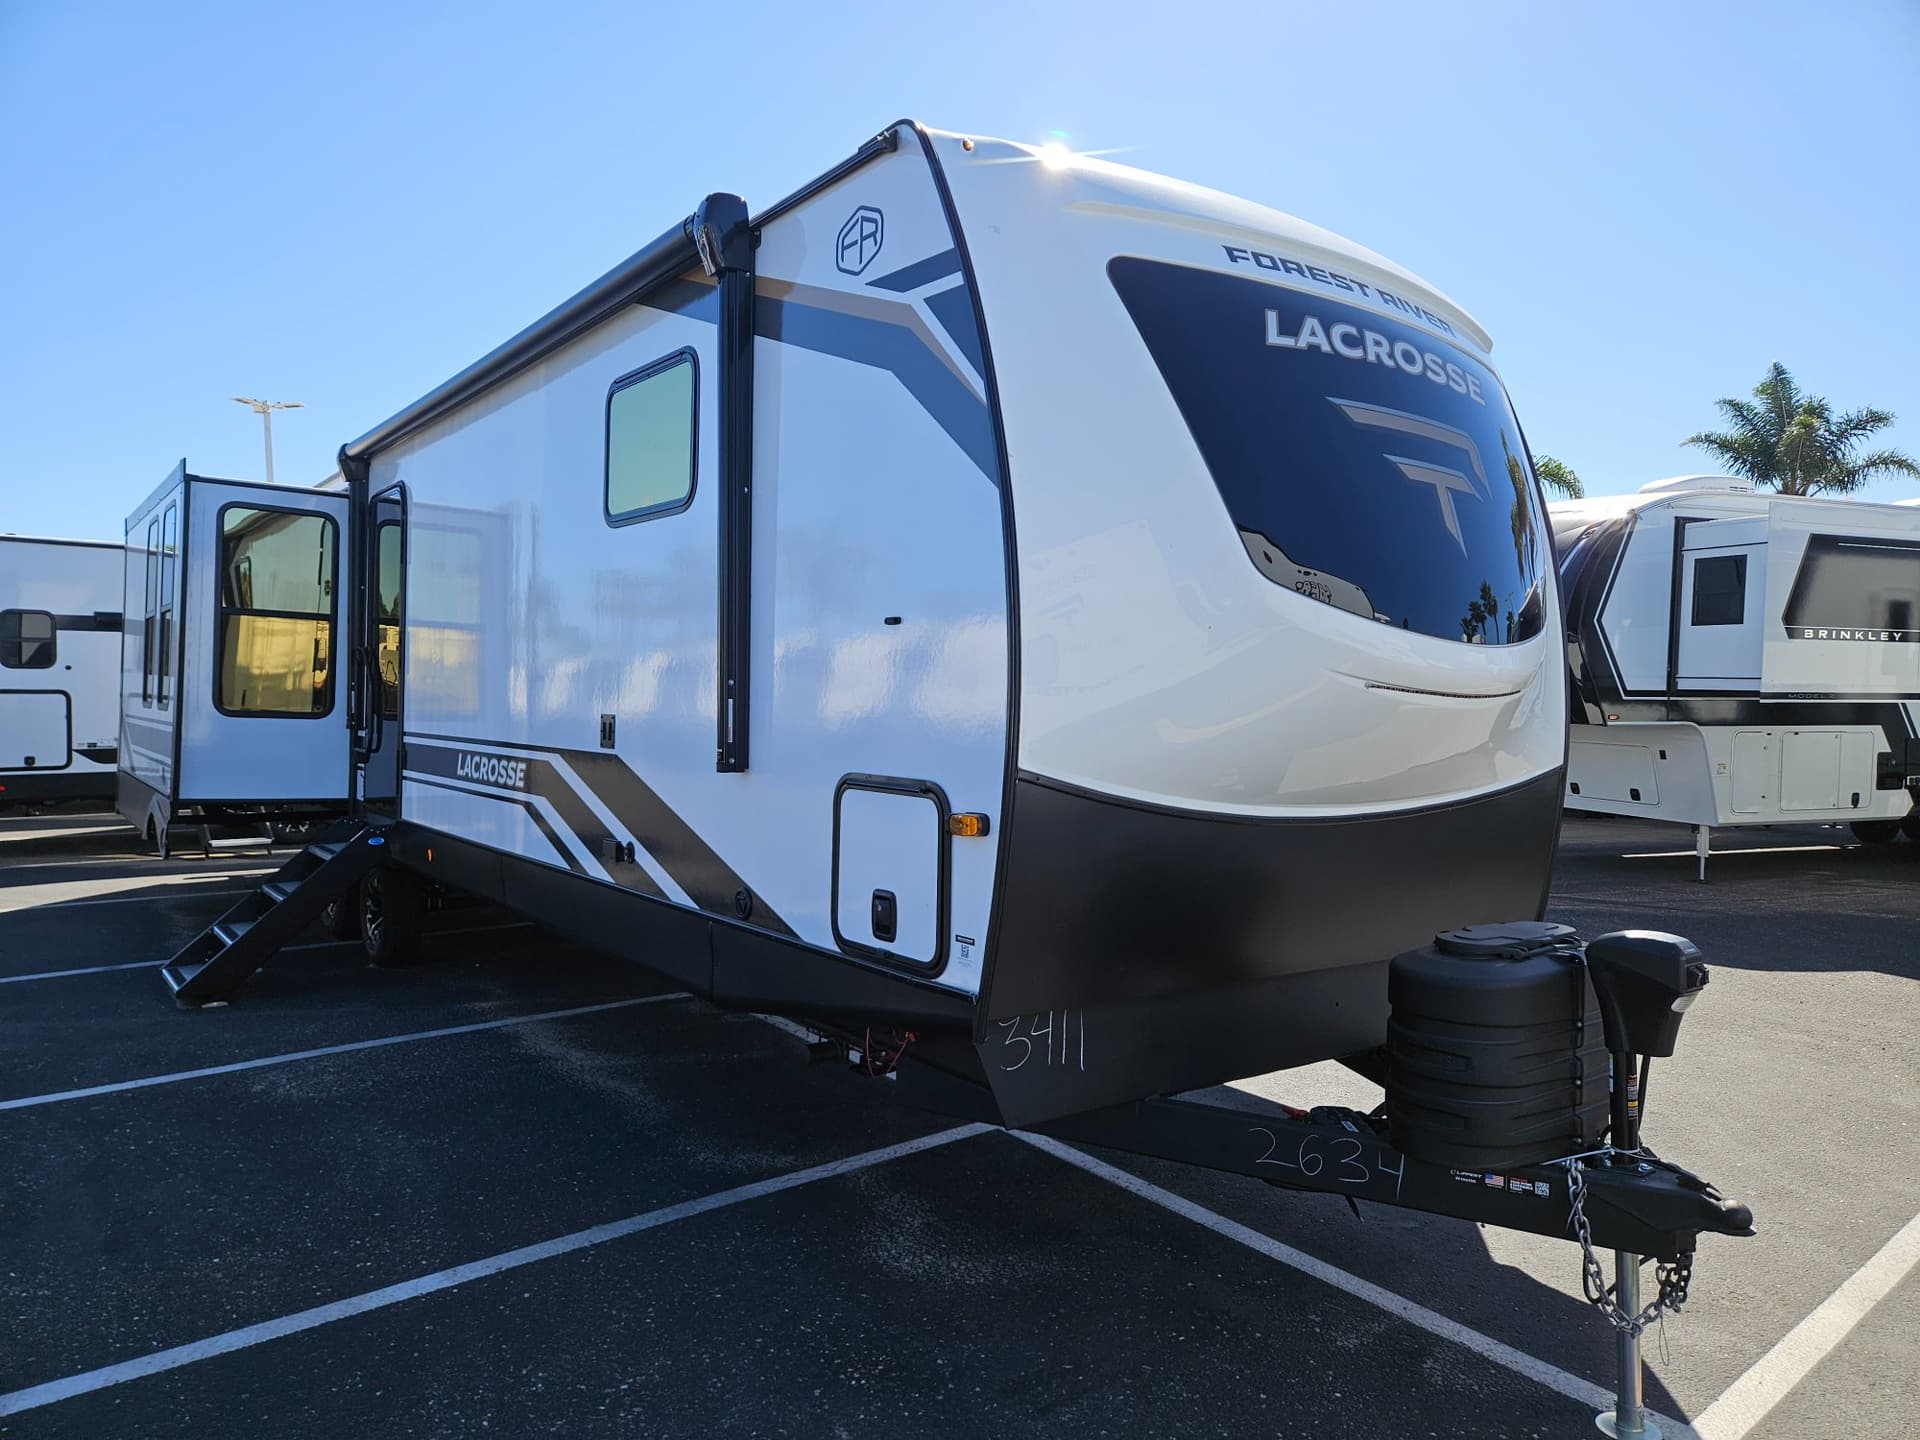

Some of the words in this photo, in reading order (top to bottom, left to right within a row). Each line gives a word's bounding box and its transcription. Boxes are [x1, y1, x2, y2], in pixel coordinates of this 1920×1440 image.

[1221, 244, 1370, 298] FOREST
[1374, 287, 1457, 338] RIVER
[1264, 307, 1487, 406] LACROSSE
[1804, 629, 1902, 641] BRINKLEY
[457, 752, 527, 788] LACROSSE
[999, 1008, 1085, 1072] 3411
[1248, 1127, 1405, 1200] 2634
